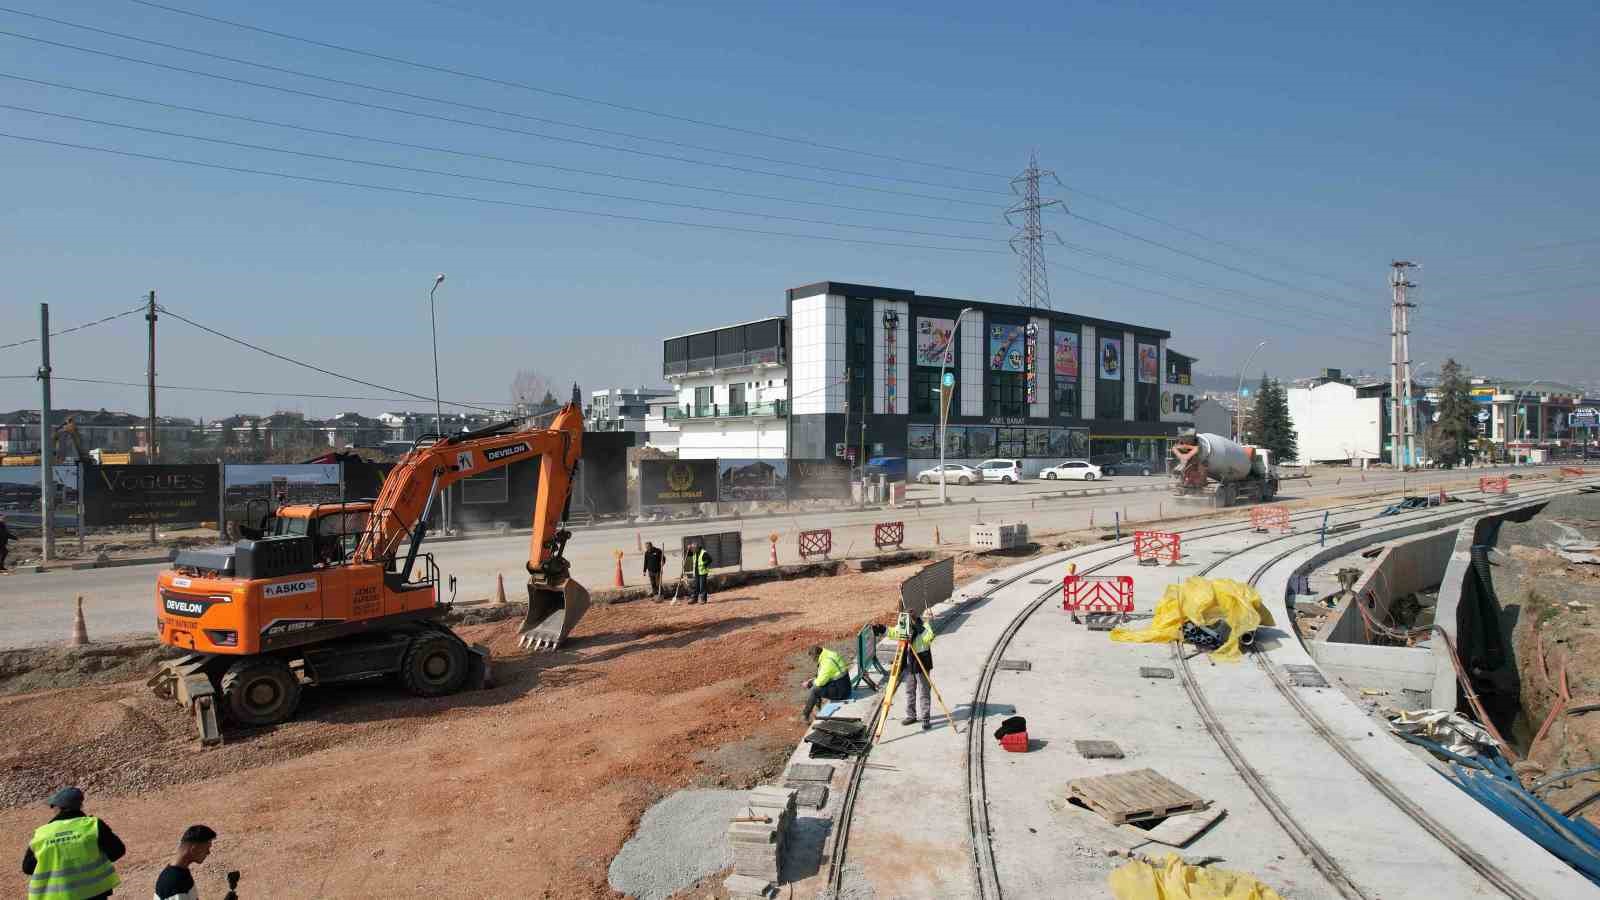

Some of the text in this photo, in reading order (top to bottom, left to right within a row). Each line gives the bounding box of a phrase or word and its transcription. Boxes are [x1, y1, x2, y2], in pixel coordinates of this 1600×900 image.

[487, 444, 525, 460] DEVELON
[101, 469, 207, 491] VOGUE'S
[275, 582, 306, 594] ASKO
[166, 599, 203, 614] DEVELON
